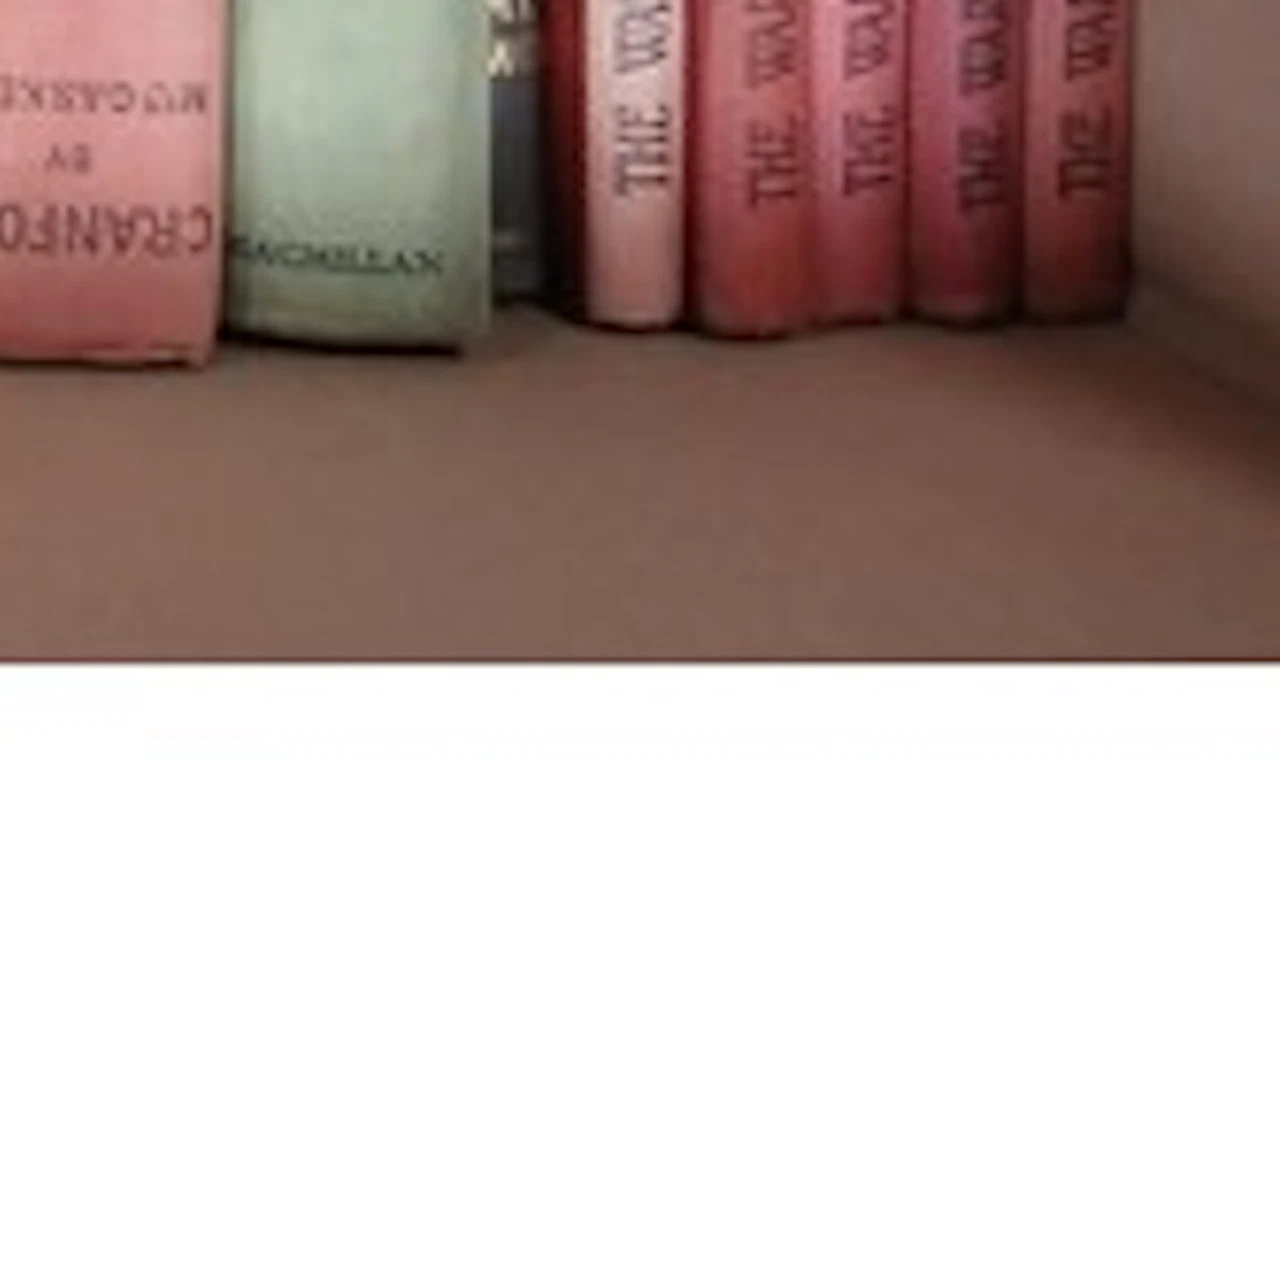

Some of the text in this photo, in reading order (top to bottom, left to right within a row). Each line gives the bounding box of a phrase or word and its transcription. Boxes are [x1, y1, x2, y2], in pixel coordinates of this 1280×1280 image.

[42, 143, 93, 175] BY
[614, 101, 672, 198] THE
[748, 113, 800, 214] THE
[841, 104, 896, 199] THE
[958, 119, 1005, 214] THE
[1058, 103, 1114, 200] THE
